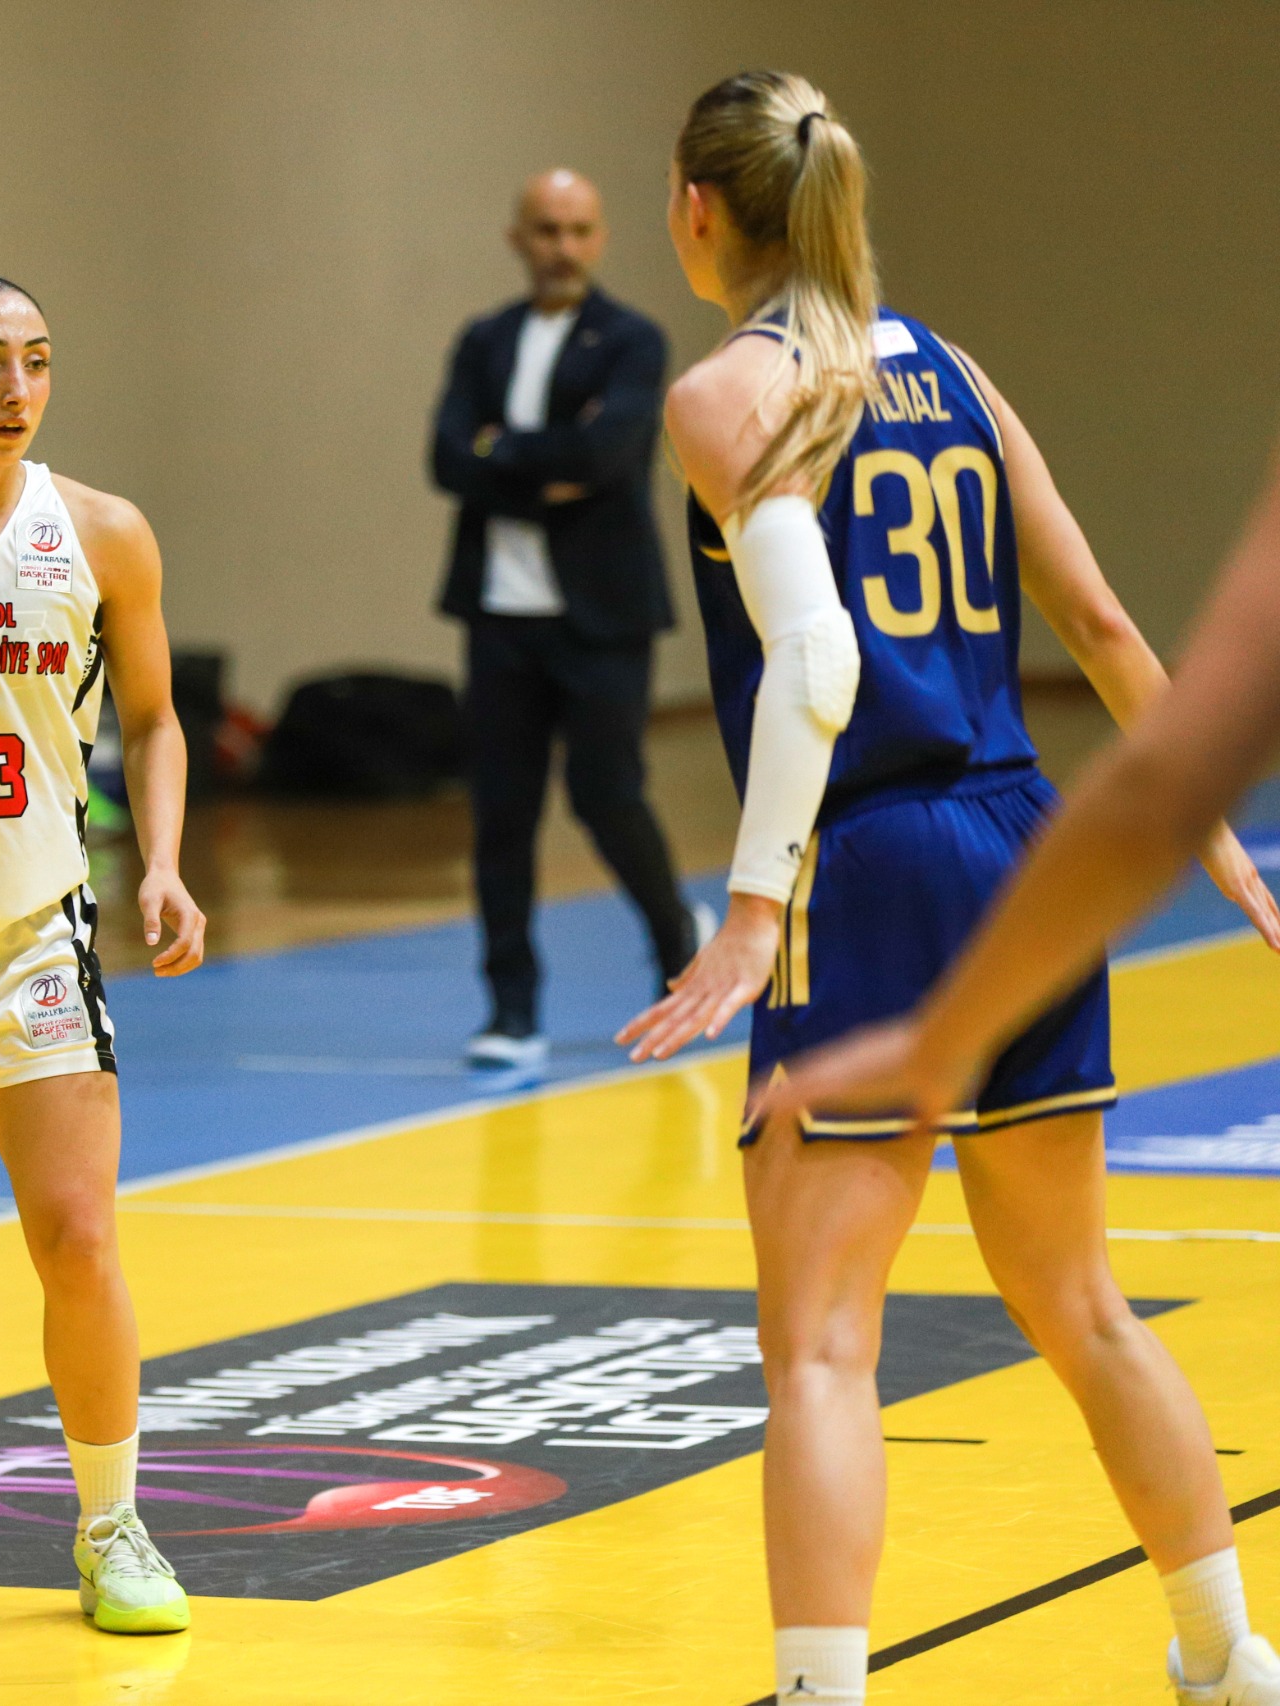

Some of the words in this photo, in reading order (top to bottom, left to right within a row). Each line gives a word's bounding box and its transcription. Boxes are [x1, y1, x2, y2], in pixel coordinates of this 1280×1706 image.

[853, 445, 1001, 637] 30
[36, 641, 70, 676] SPOR
[37, 1005, 81, 1019] HALKBANK
[369, 1326, 764, 1445] BASKETBO
